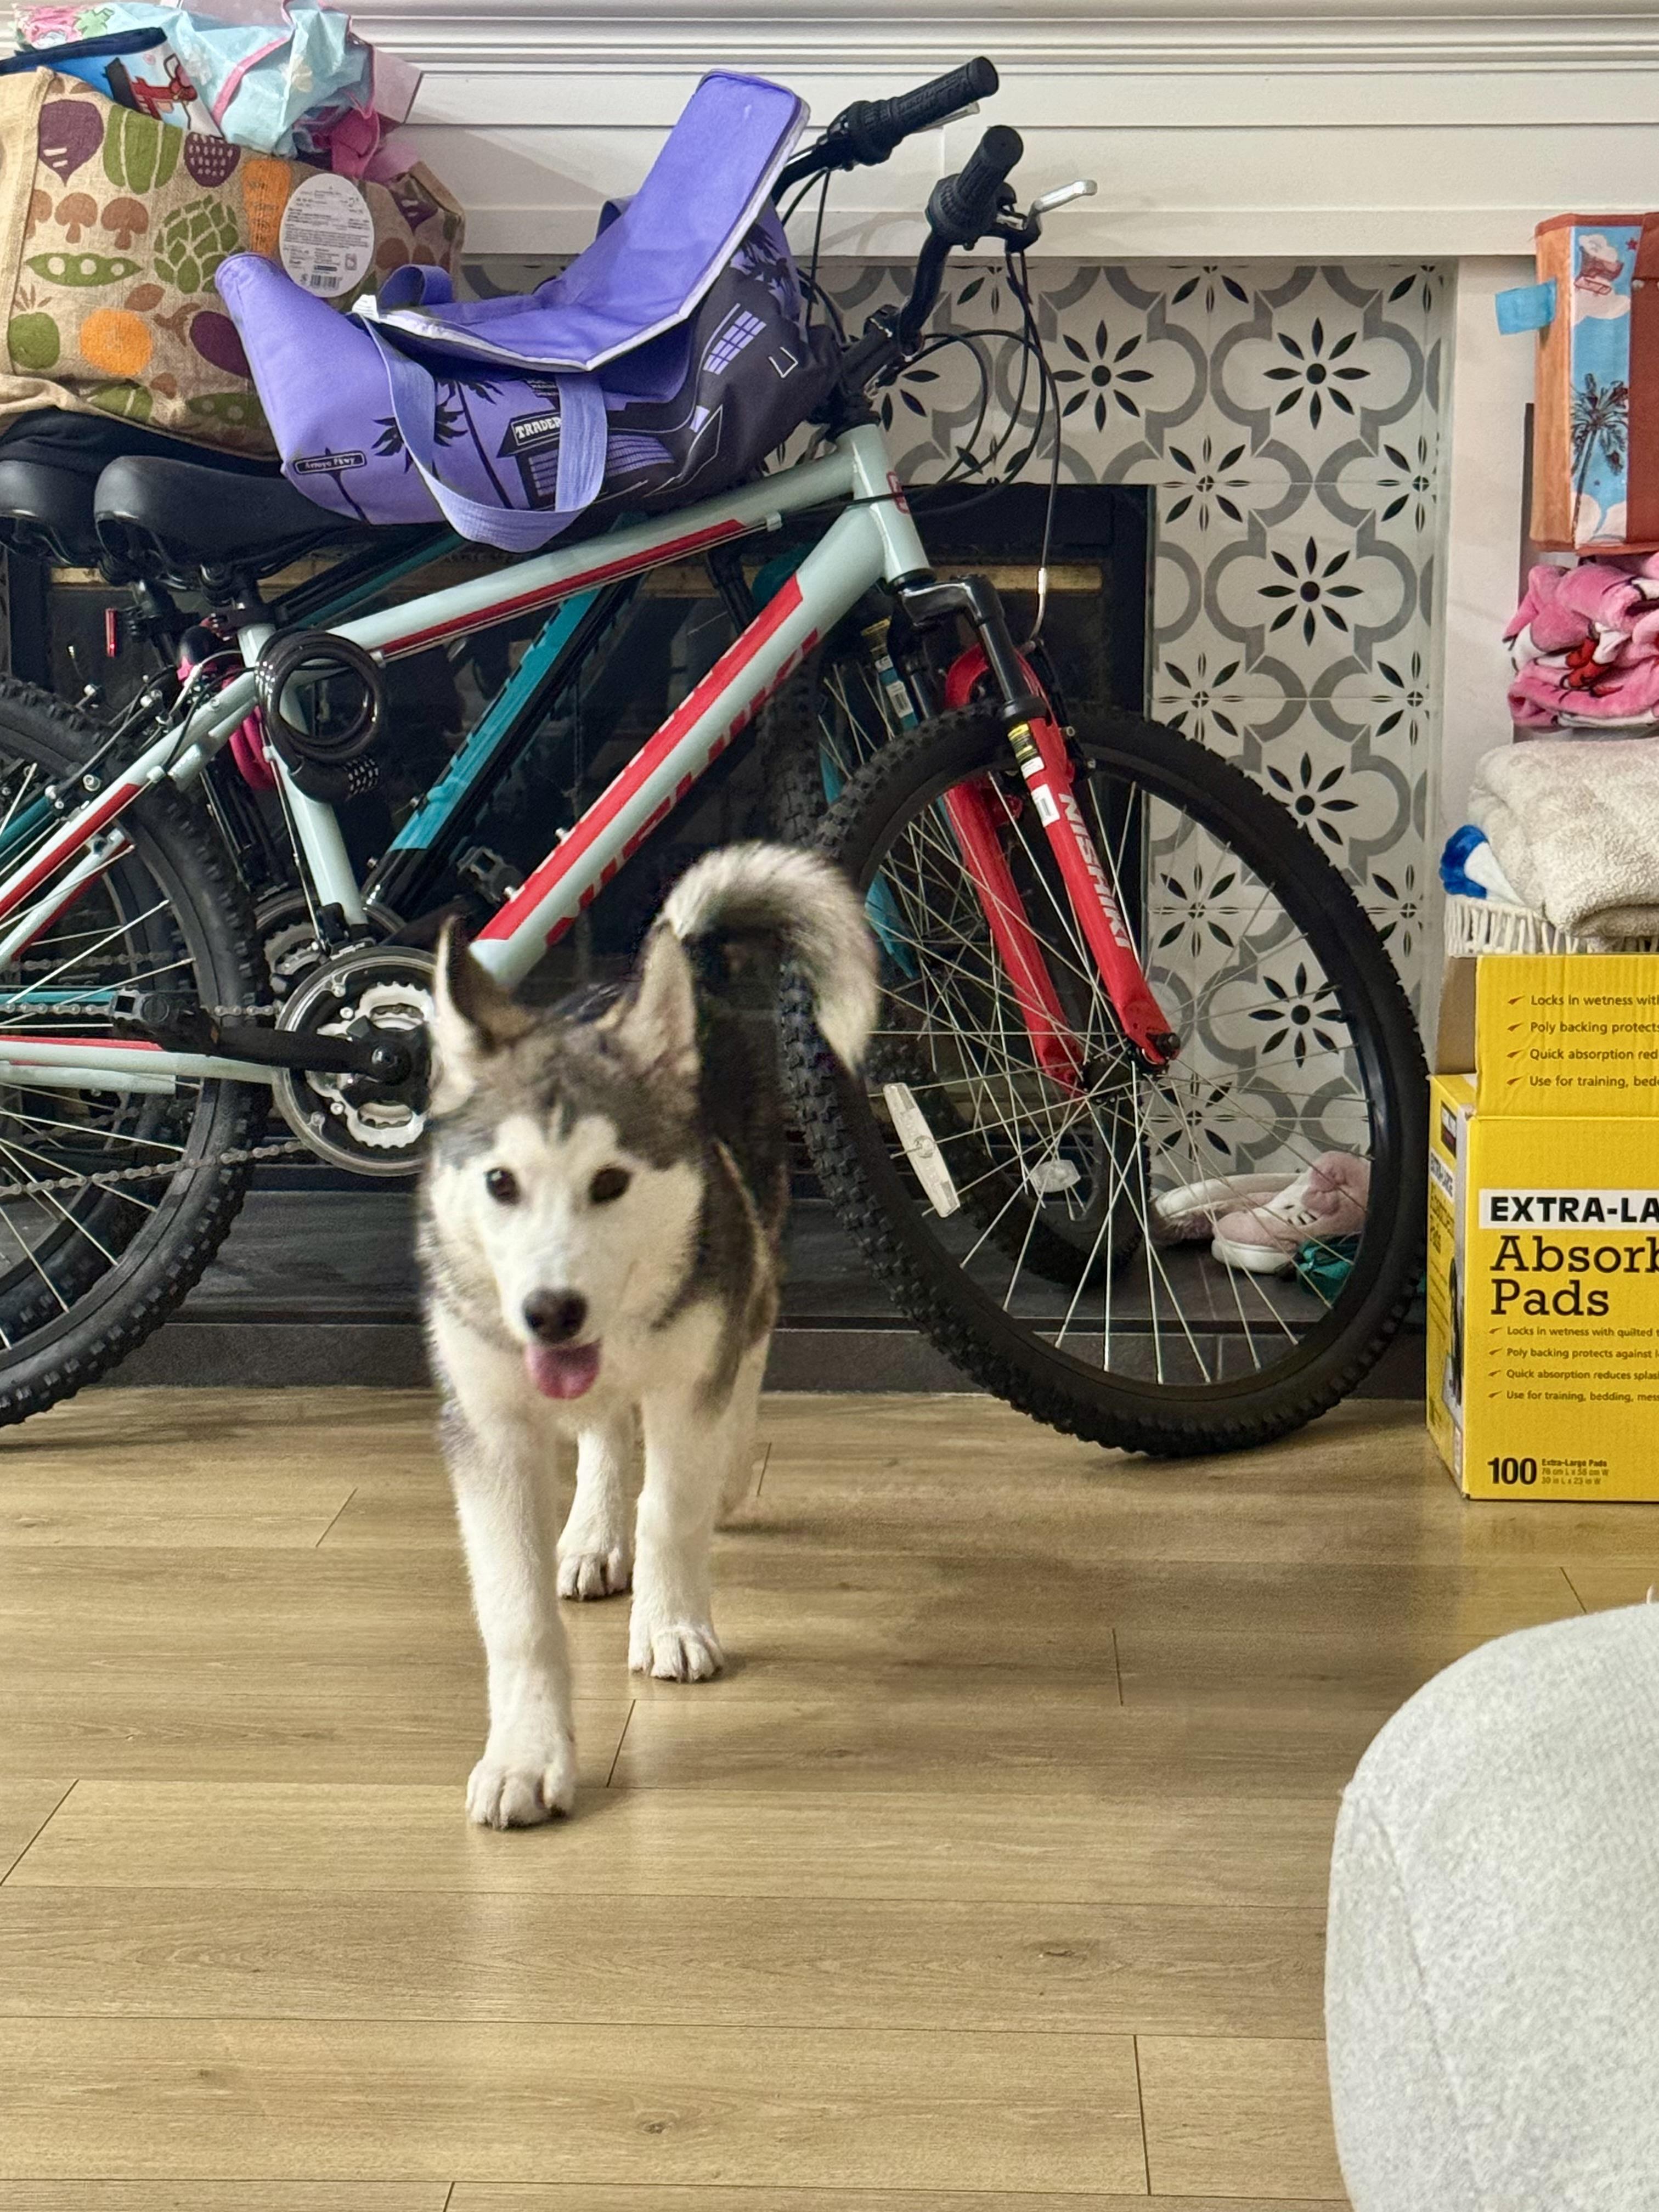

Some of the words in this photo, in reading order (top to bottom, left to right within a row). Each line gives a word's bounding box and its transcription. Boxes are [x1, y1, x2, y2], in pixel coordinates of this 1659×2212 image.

[515, 417, 561, 438] TRADER
[1531, 995, 1564, 1005] Locks
[1568, 994, 1579, 1005] in
[1583, 995, 1633, 1006] wetness
[1531, 1022, 1556, 1035] Poly
[1560, 1021, 1607, 1035] backing
[1530, 1048, 1564, 1060] Quick
[1568, 1048, 1634, 1062] absorption
[1530, 1076, 1551, 1086] Use
[1556, 1075, 1573, 1086] for
[1577, 1075, 1629, 1088] training,
[1633, 1075, 1659, 1087] bed
[1491, 1196, 1659, 1223] EXTRA-LA
[1491, 1278, 1609, 1317] Pads
[1507, 1326, 1534, 1335] Locks
[1537, 1326, 1547, 1335] in
[1549, 1327, 1589, 1336] wetness
[1592, 1327, 1614, 1336] with
[1617, 1327, 1652, 1338] quilted
[1506, 1348, 1528, 1359] Poly
[1530, 1348, 1569, 1359] backing
[1572, 1349, 1613, 1359] protects
[1616, 1350, 1652, 1360] against
[1506, 1369, 1534, 1379] Quick
[1537, 1369, 1590, 1380] absorption
[1593, 1370, 1631, 1380] reduces
[1506, 1391, 1524, 1400] Use
[1527, 1391, 1542, 1400] for
[1545, 1391, 1586, 1402] training,
[1590, 1392, 1634, 1402] bedding,
[1542, 1458, 1587, 1467] Extra-Large
[1588, 1459, 1607, 1467] Pads
[1487, 1457, 1537, 1485] 100
